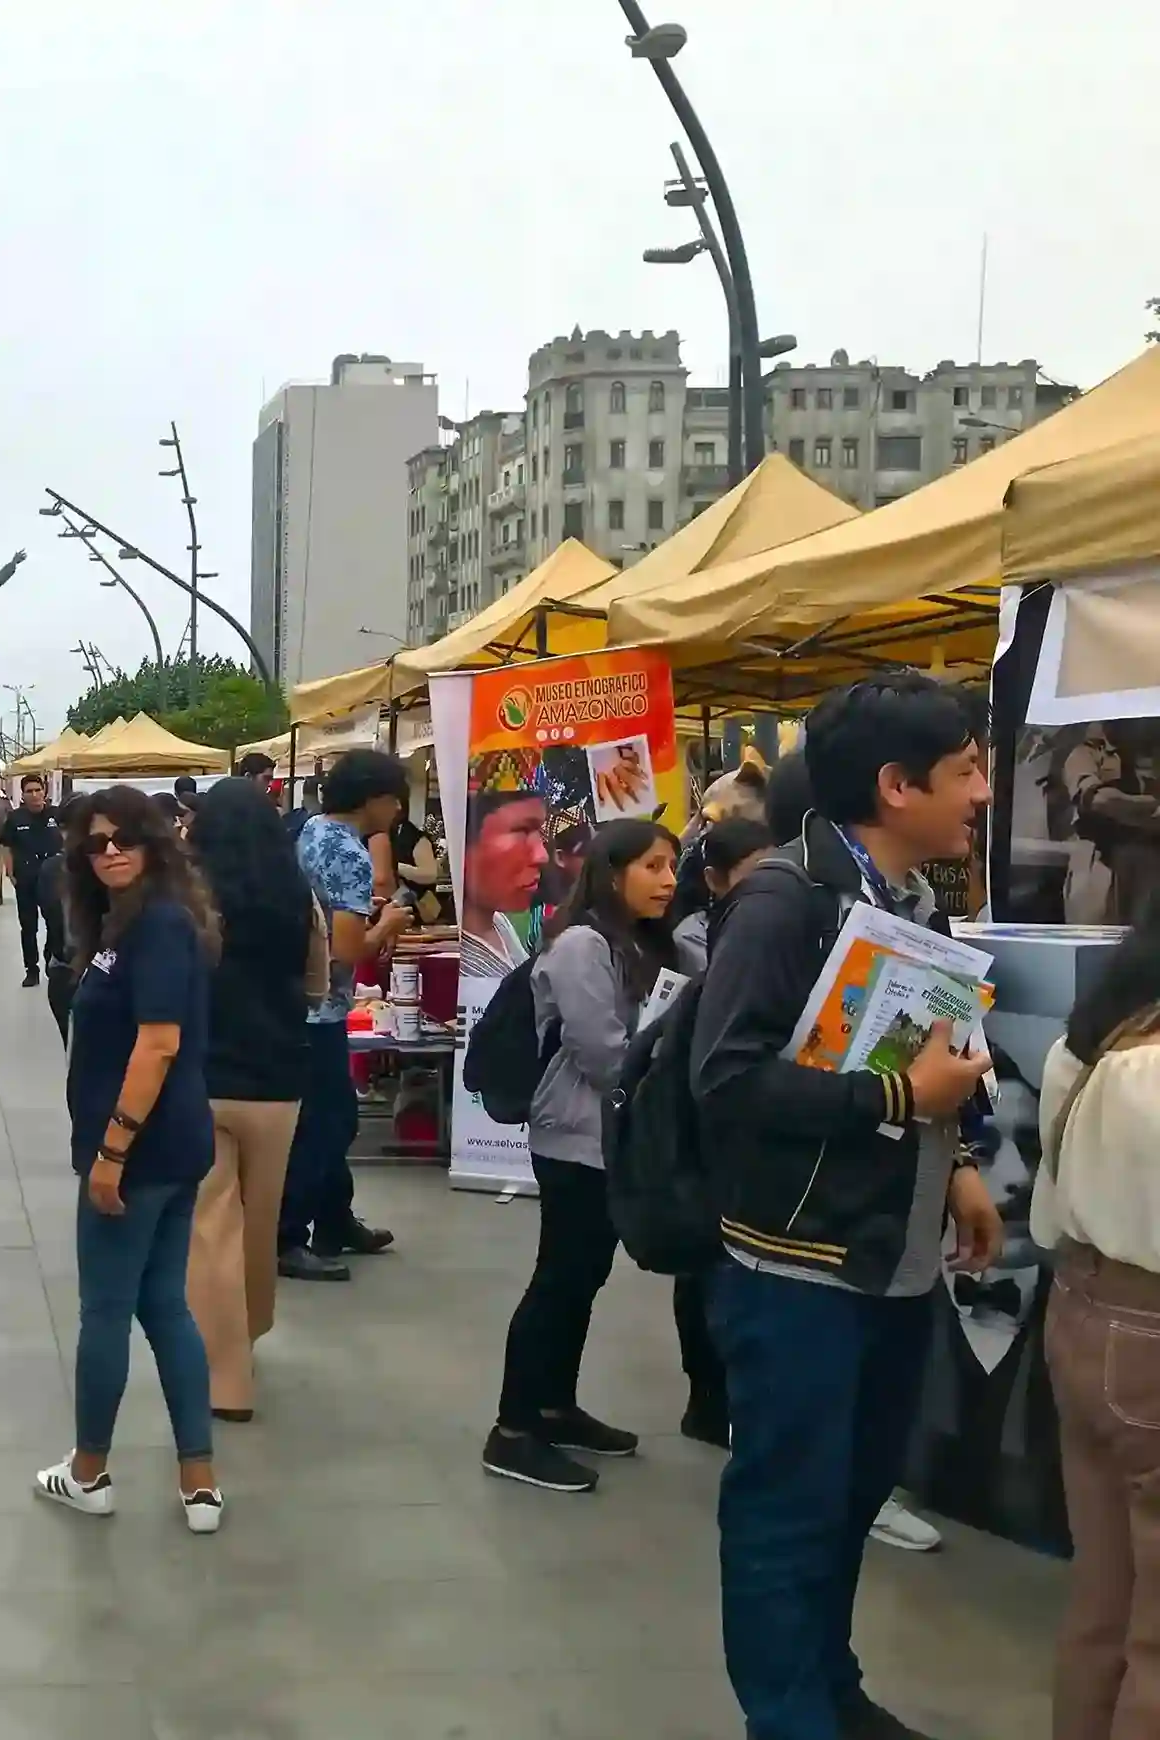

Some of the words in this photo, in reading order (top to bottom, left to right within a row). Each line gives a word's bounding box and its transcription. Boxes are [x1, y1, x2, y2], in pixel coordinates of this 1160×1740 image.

[535, 683, 572, 703] MUSEO
[574, 673, 647, 698] ETNOGRAFICO
[921, 989, 972, 1023] ETHNOGRAPHIC
[931, 985, 972, 1013] AMAZONIAN
[466, 1137, 531, 1151] www.selvas
